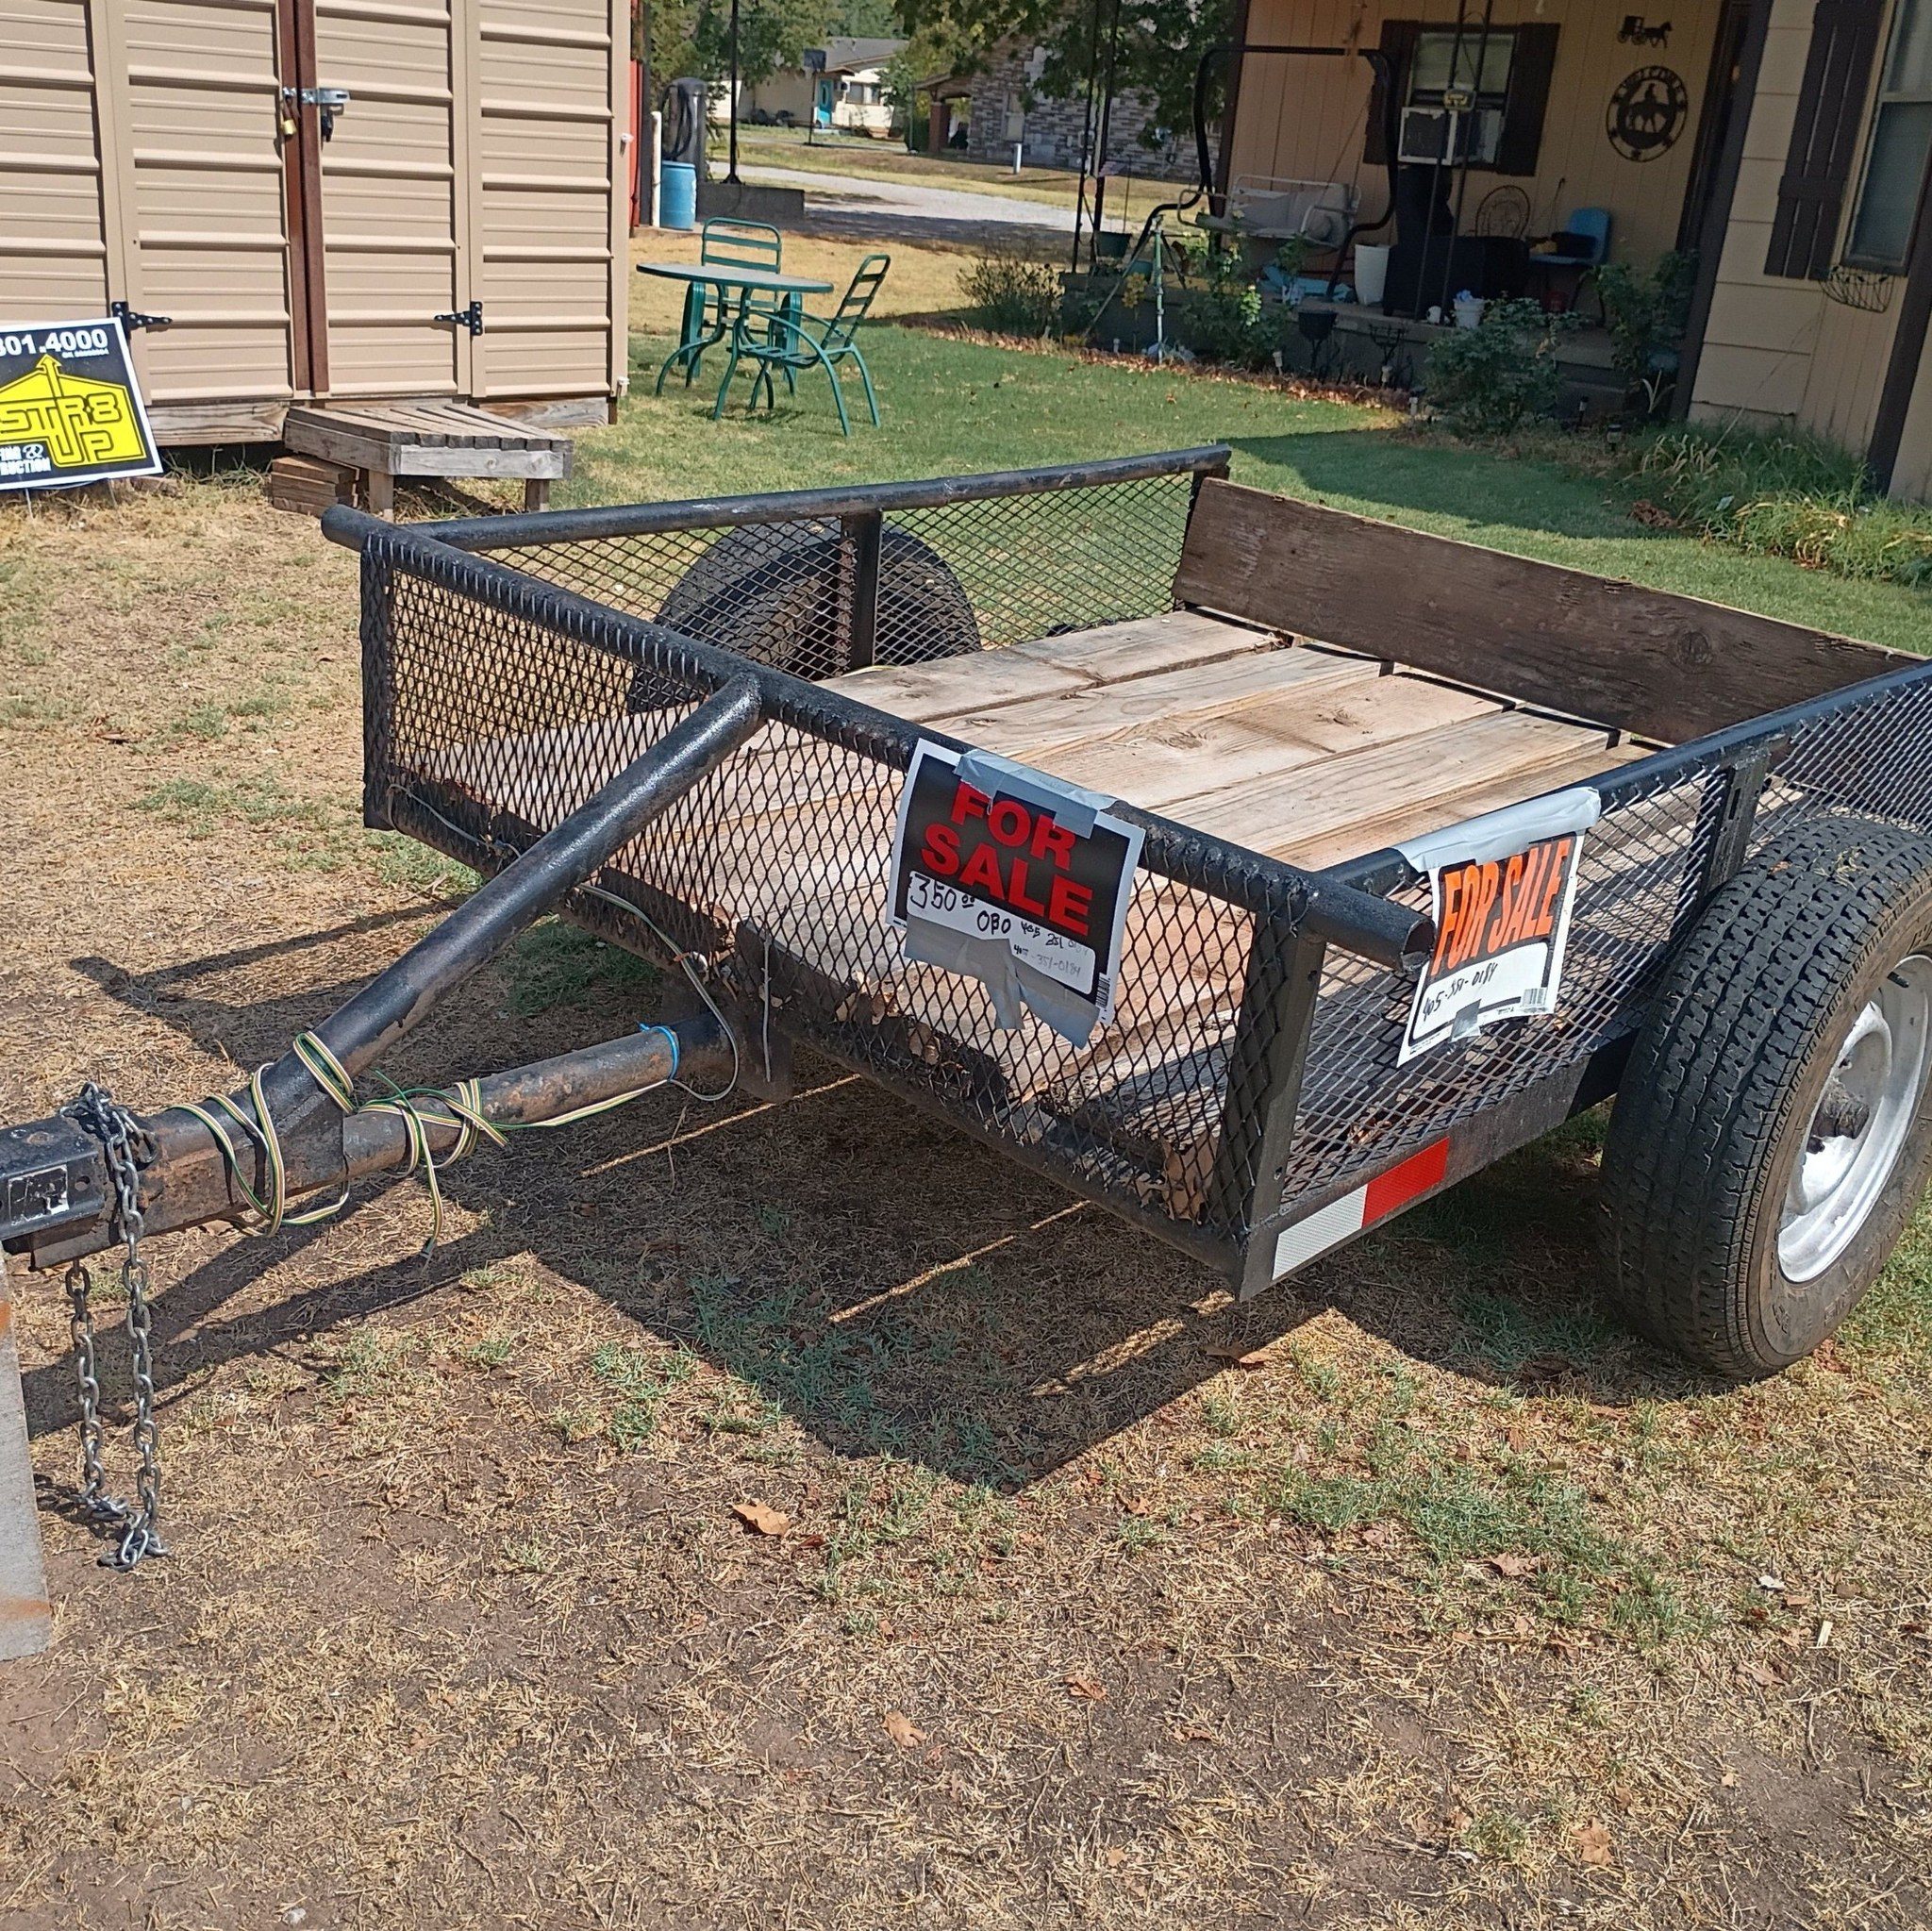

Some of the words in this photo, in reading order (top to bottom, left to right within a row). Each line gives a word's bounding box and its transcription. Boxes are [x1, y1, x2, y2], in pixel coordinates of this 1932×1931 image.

[0, 457, 52, 476] RUCTION
[951, 780, 1076, 871] FOR
[921, 823, 1093, 936] SALE
[976, 910, 1011, 935] OBO
[1431, 860, 1500, 976] FOR
[1487, 839, 1572, 953] SALE
